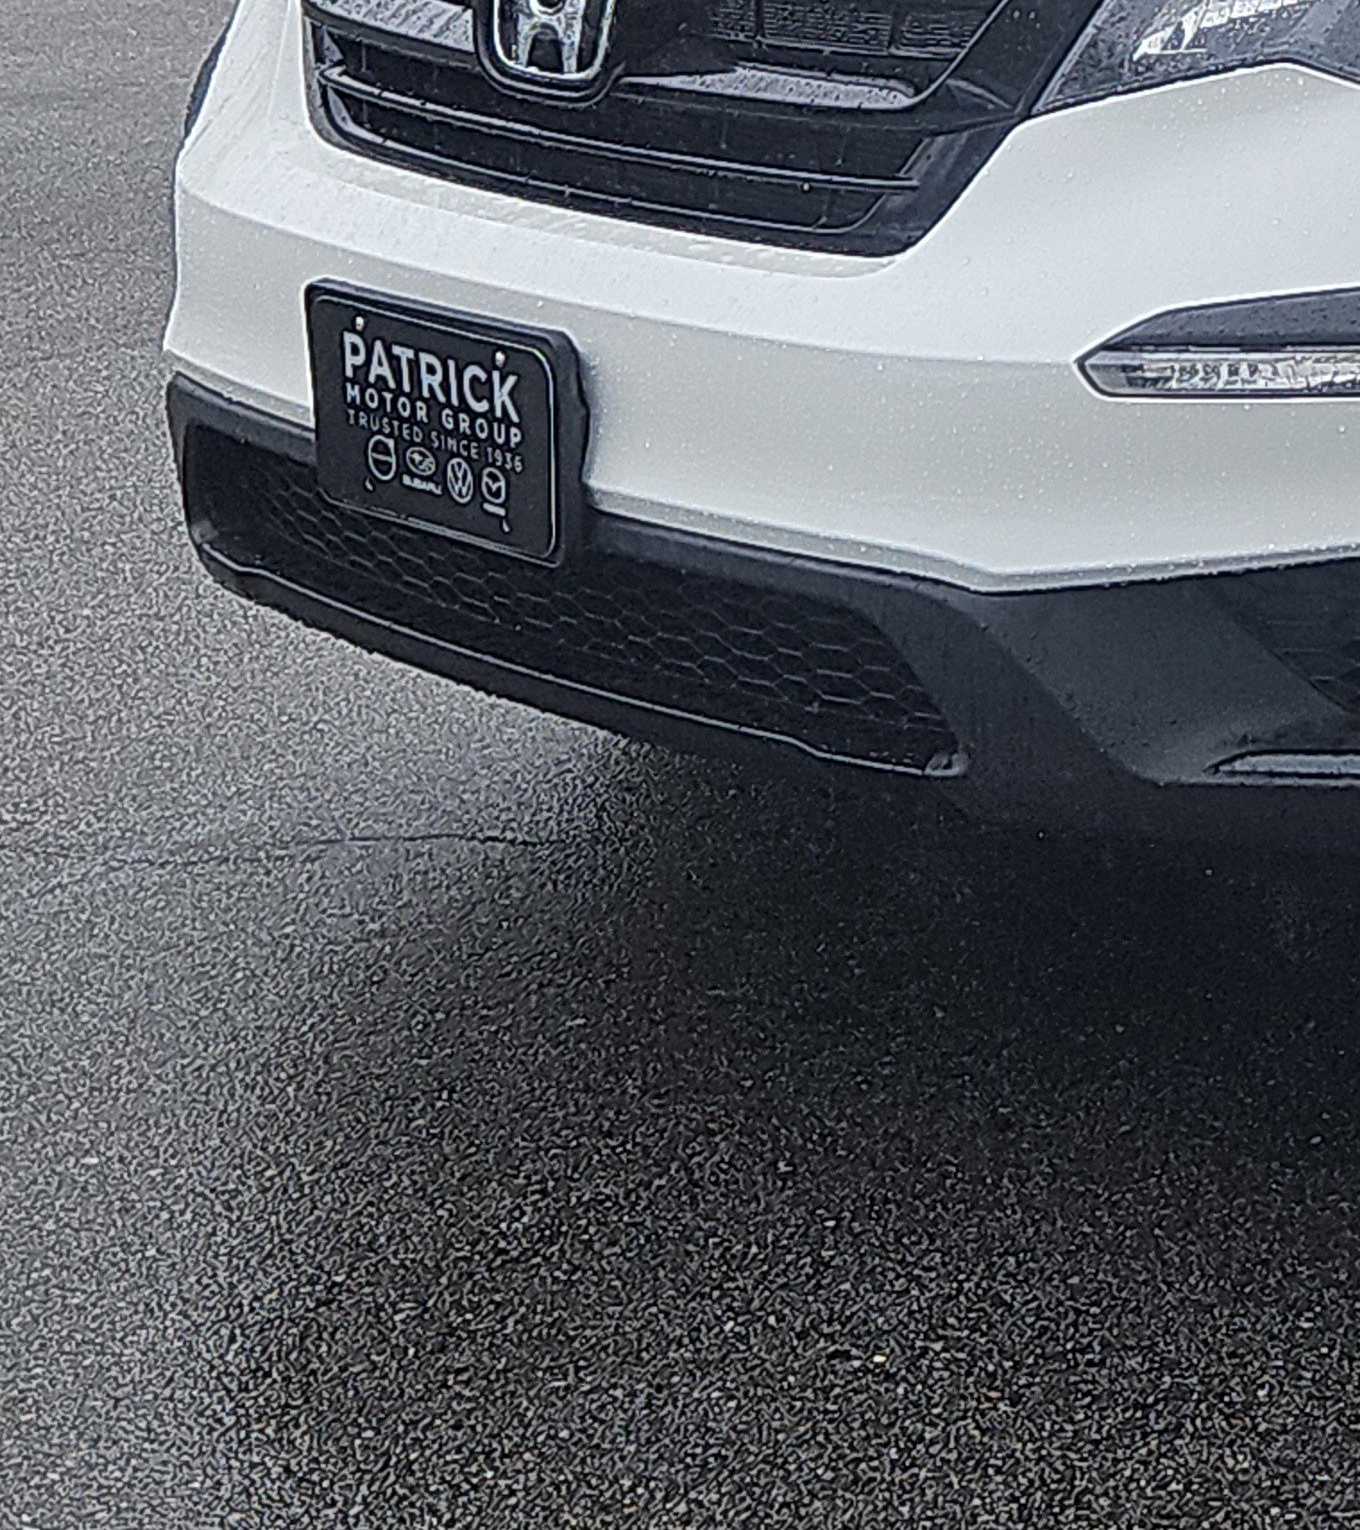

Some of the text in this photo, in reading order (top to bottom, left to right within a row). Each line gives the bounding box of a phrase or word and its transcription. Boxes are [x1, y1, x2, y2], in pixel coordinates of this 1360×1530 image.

[343, 331, 520, 423] PATRICK
[345, 382, 522, 448] MOTOR GROUP
[346, 409, 424, 443] TRUSTED
[430, 430, 479, 459] SINCE
